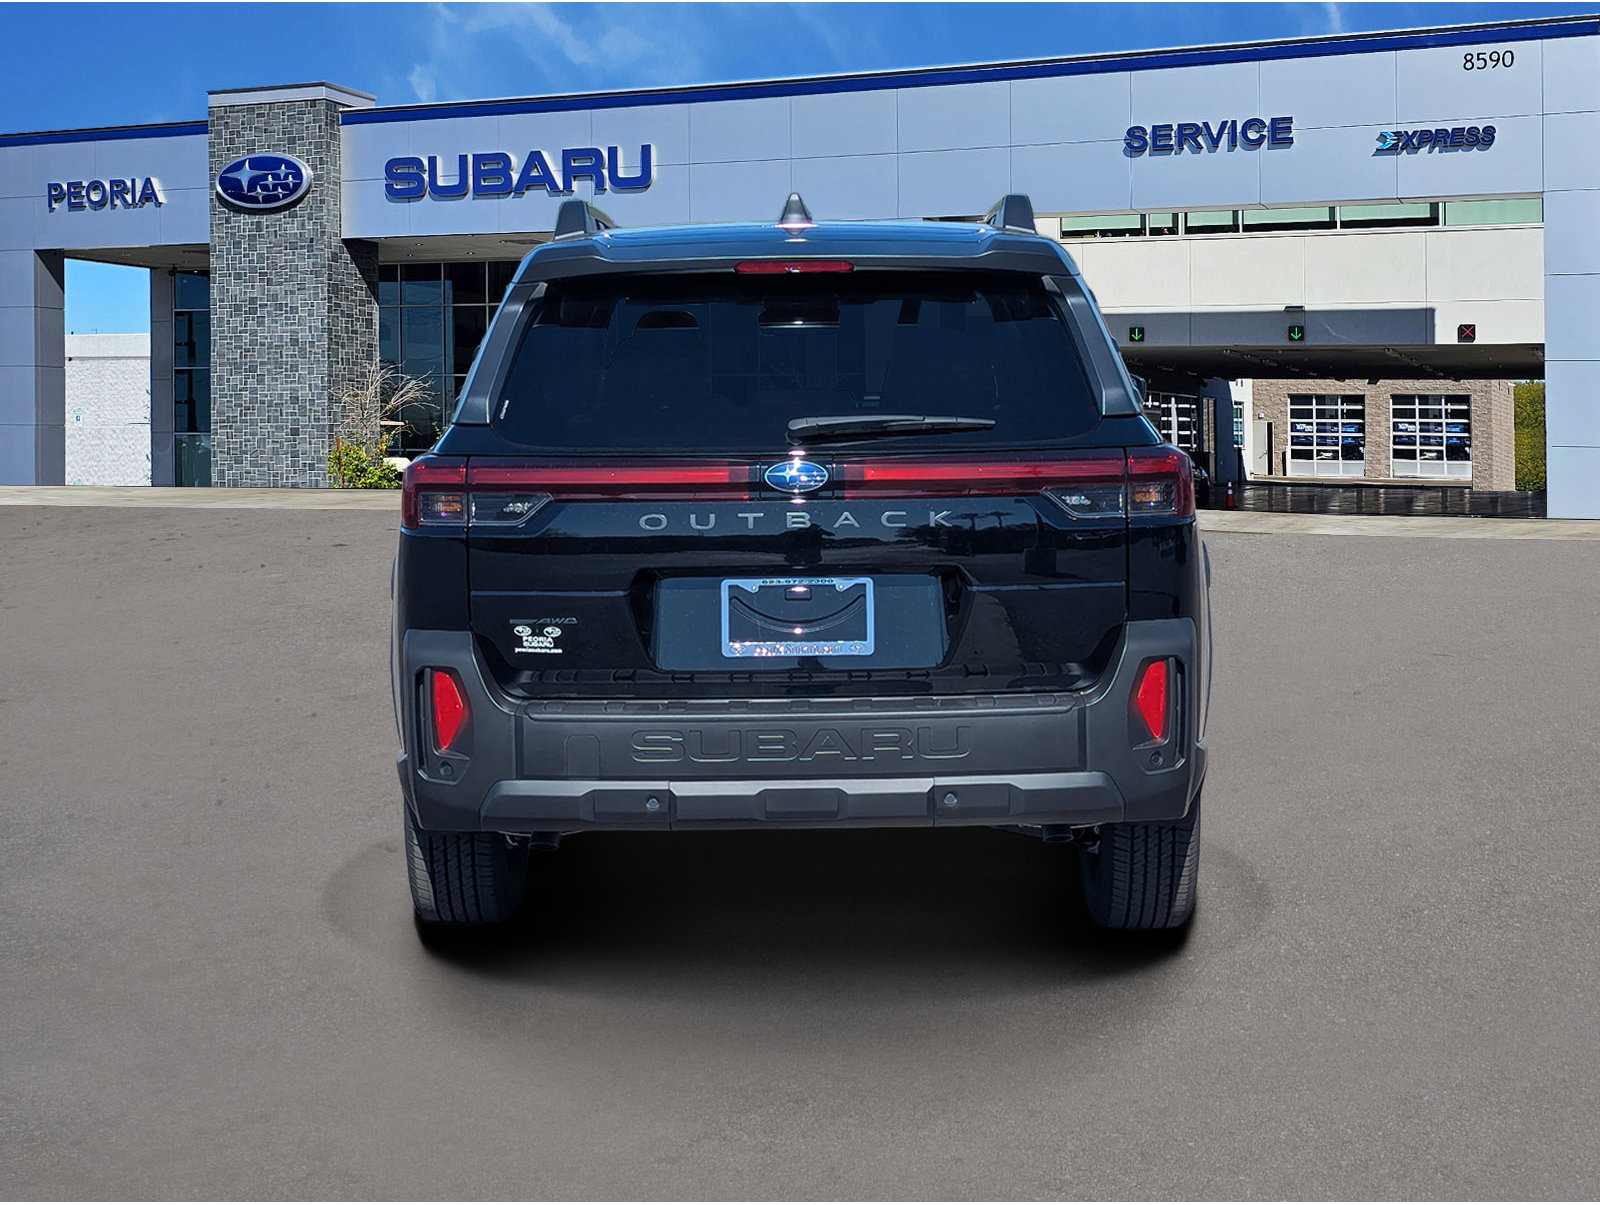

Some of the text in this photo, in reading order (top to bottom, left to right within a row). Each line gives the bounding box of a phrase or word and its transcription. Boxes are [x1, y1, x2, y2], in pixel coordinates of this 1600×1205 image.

[1463, 50, 1515, 71] 8590
[1125, 117, 1293, 156] SERVICE
[1374, 126, 1496, 156] EXPRESS
[385, 144, 653, 201] SUBARU
[48, 176, 162, 211] PEORIA
[638, 511, 955, 532] OUTBACK
[537, 616, 577, 625] AWD
[631, 727, 971, 764] SUBARU
